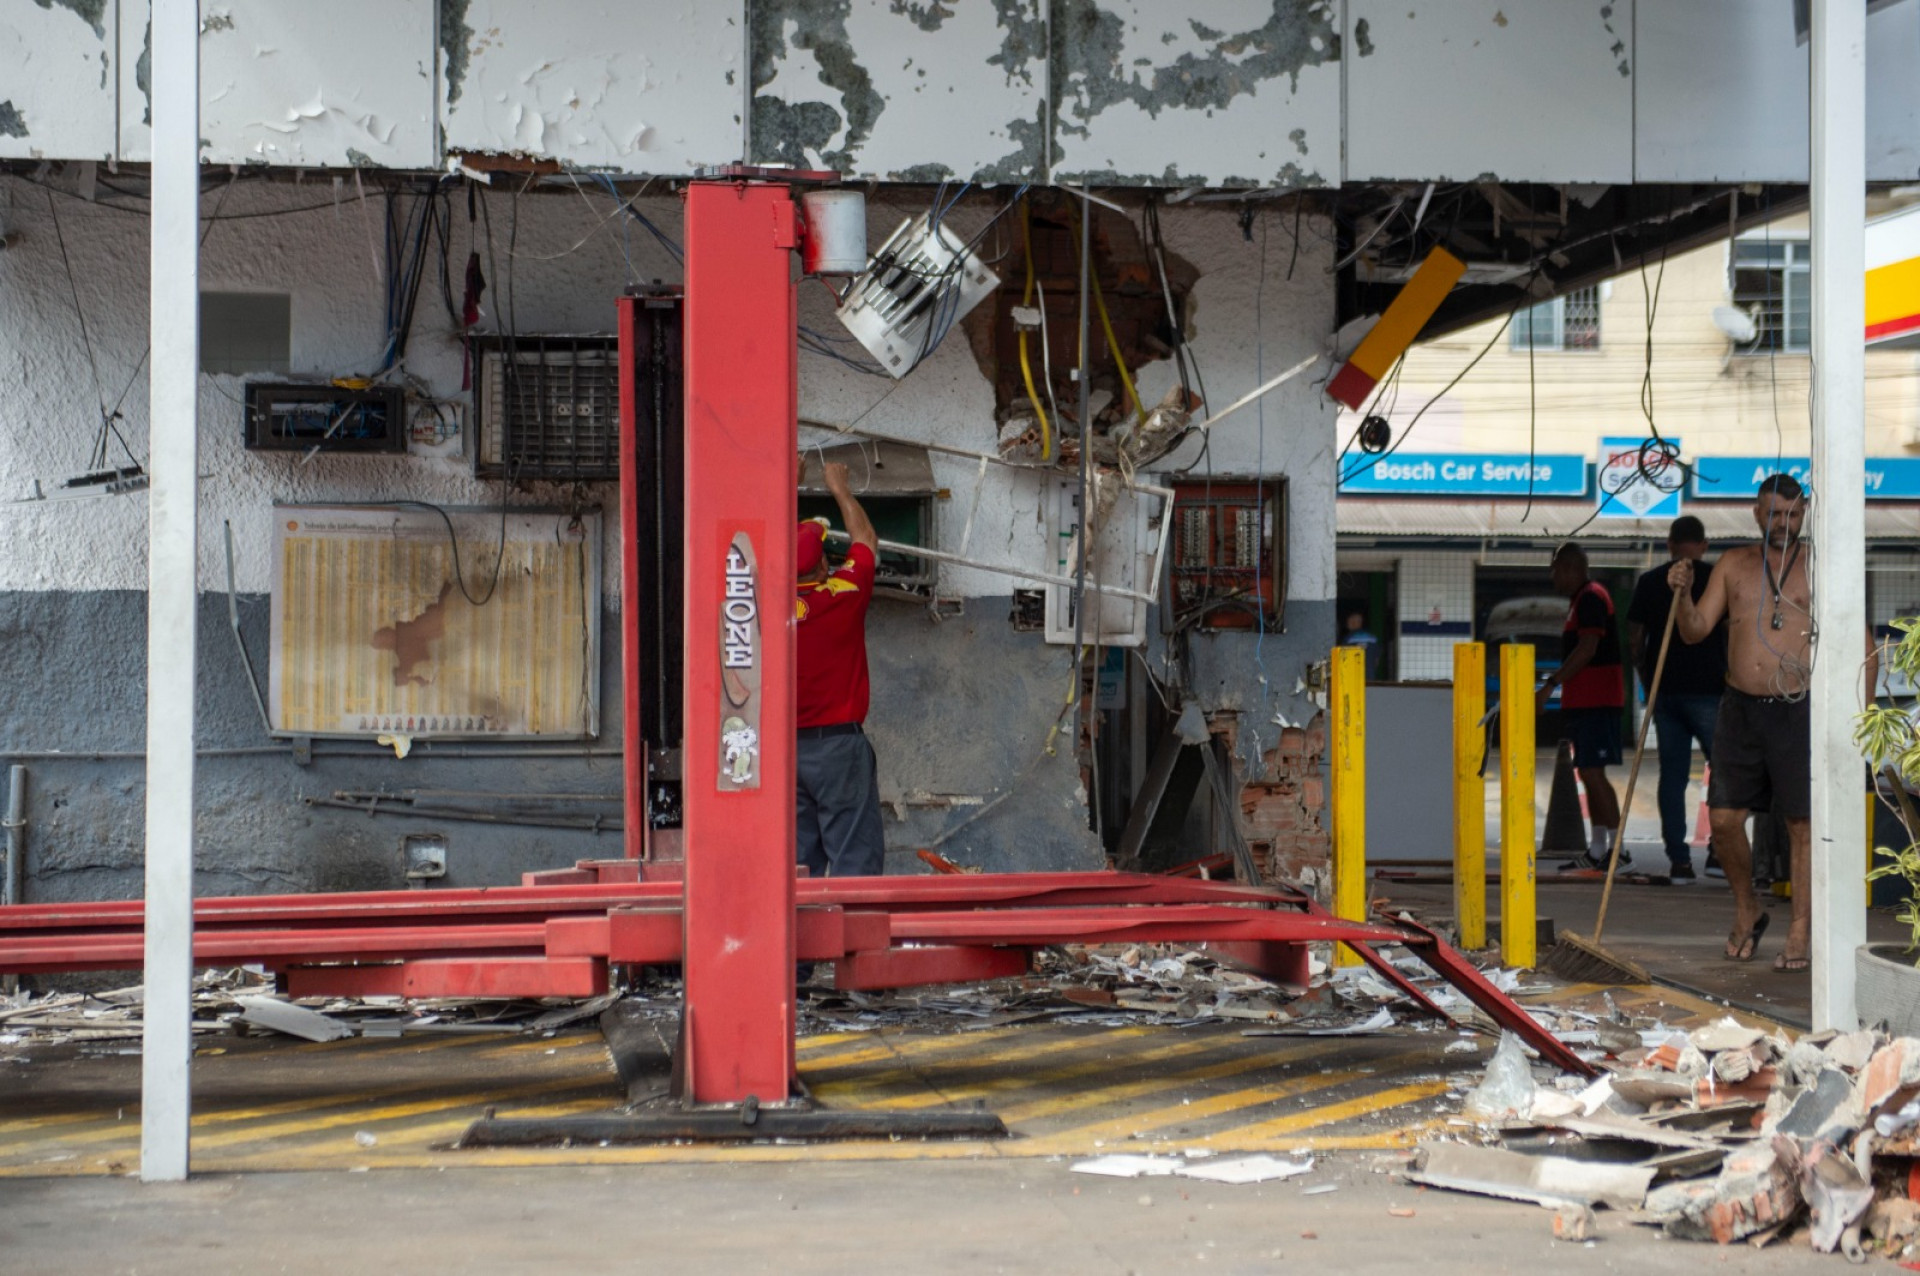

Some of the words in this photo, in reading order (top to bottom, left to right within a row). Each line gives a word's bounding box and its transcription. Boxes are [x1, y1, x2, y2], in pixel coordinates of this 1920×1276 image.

[1373, 461, 1435, 480] Bosch
[1441, 461, 1476, 481] Car
[1481, 461, 1553, 481] Service
[725, 554, 756, 669] LEONE
